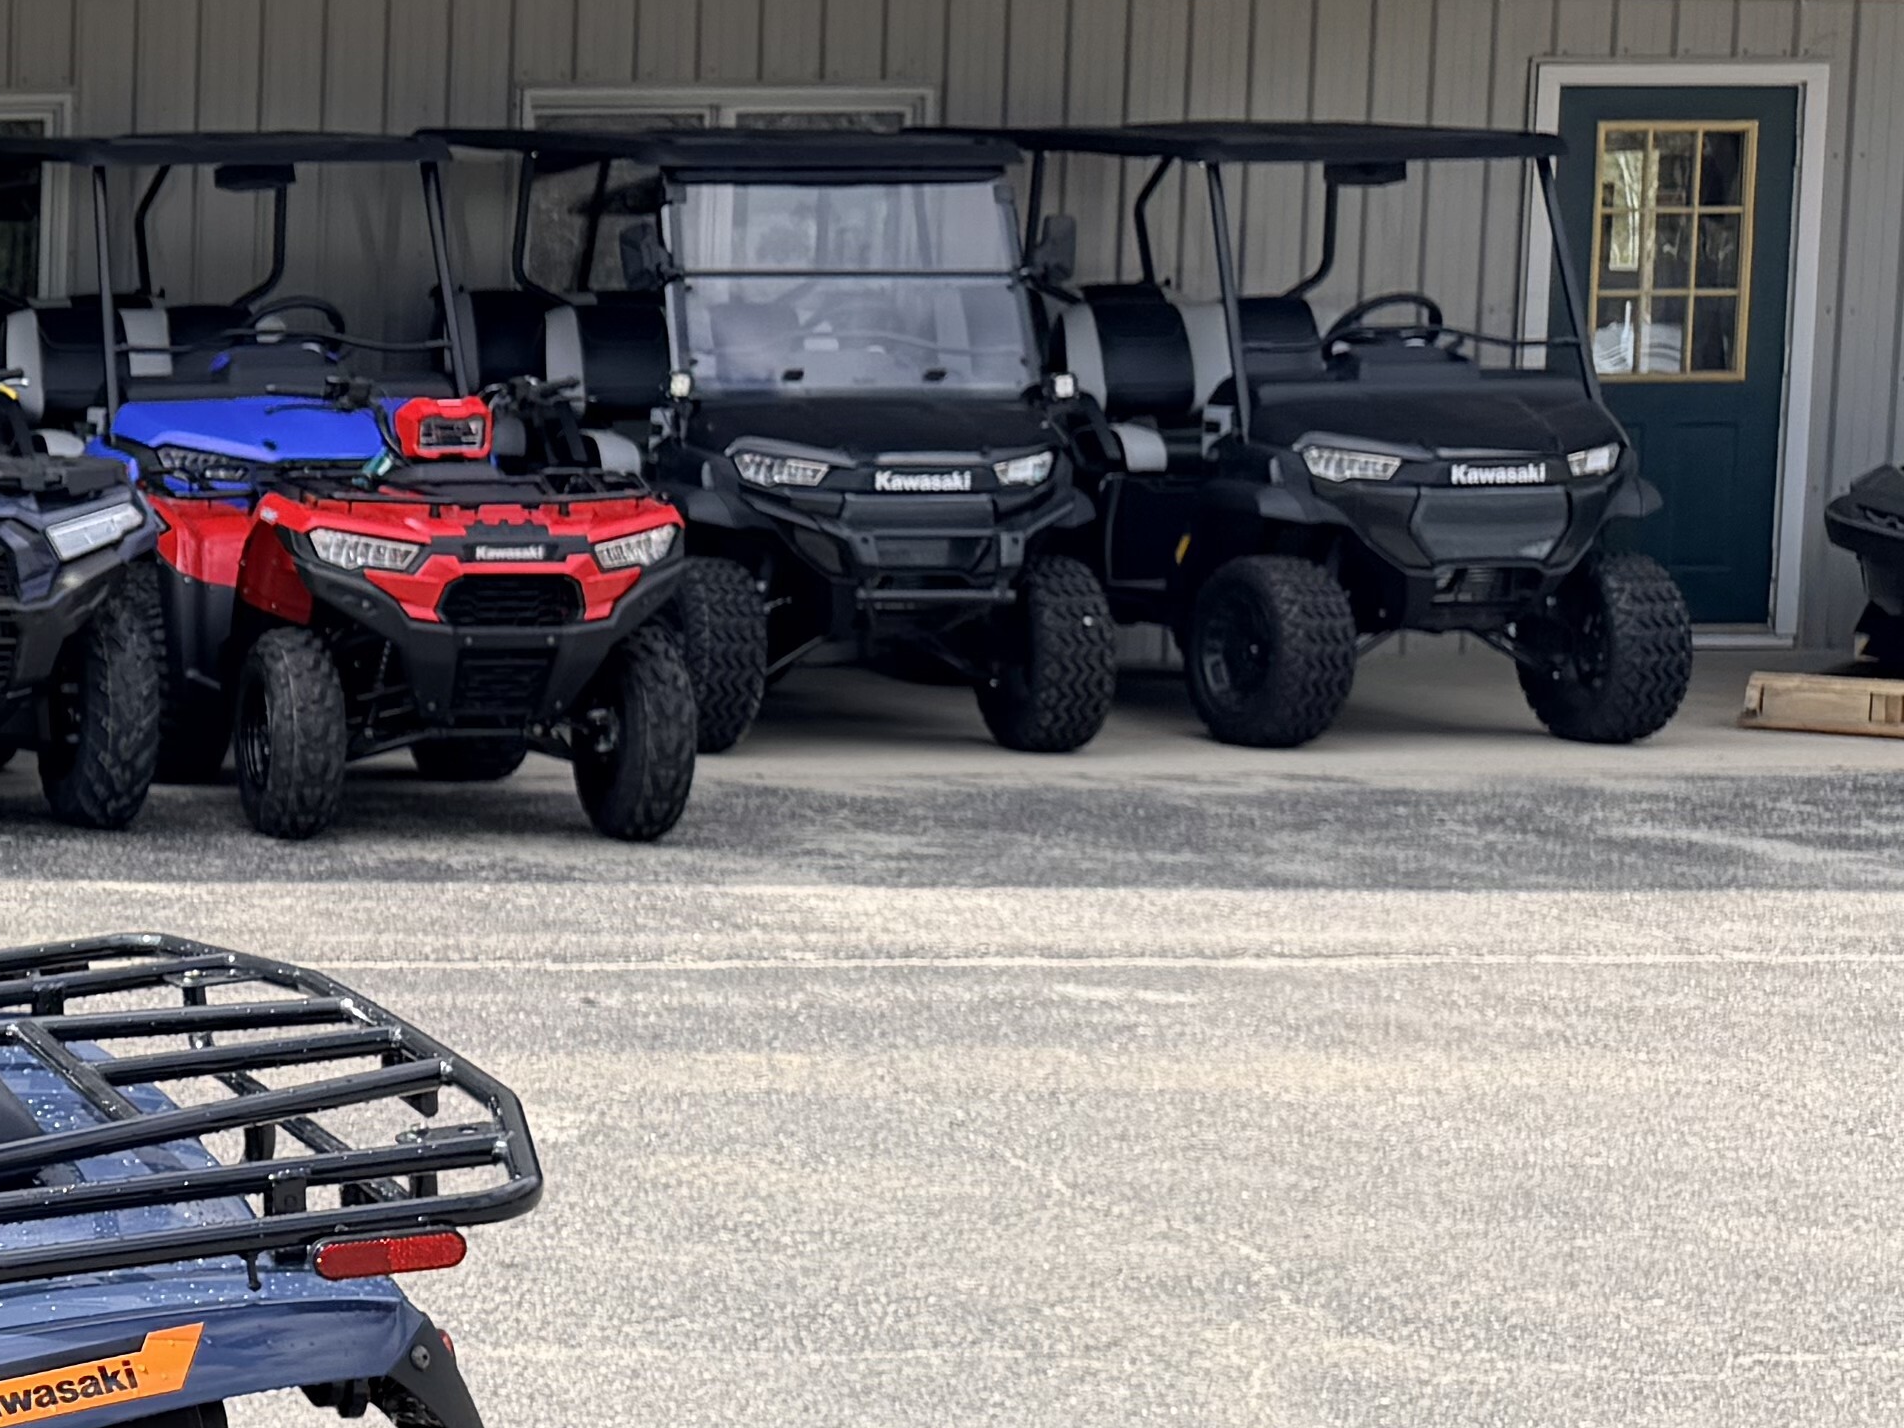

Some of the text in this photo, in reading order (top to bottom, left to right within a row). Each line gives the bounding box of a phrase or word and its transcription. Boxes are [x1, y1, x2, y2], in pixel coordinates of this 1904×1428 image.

[874, 469, 972, 491] Kawasaki
[1450, 462, 1546, 485] Kawasaki
[475, 544, 545, 560] Kawasaki
